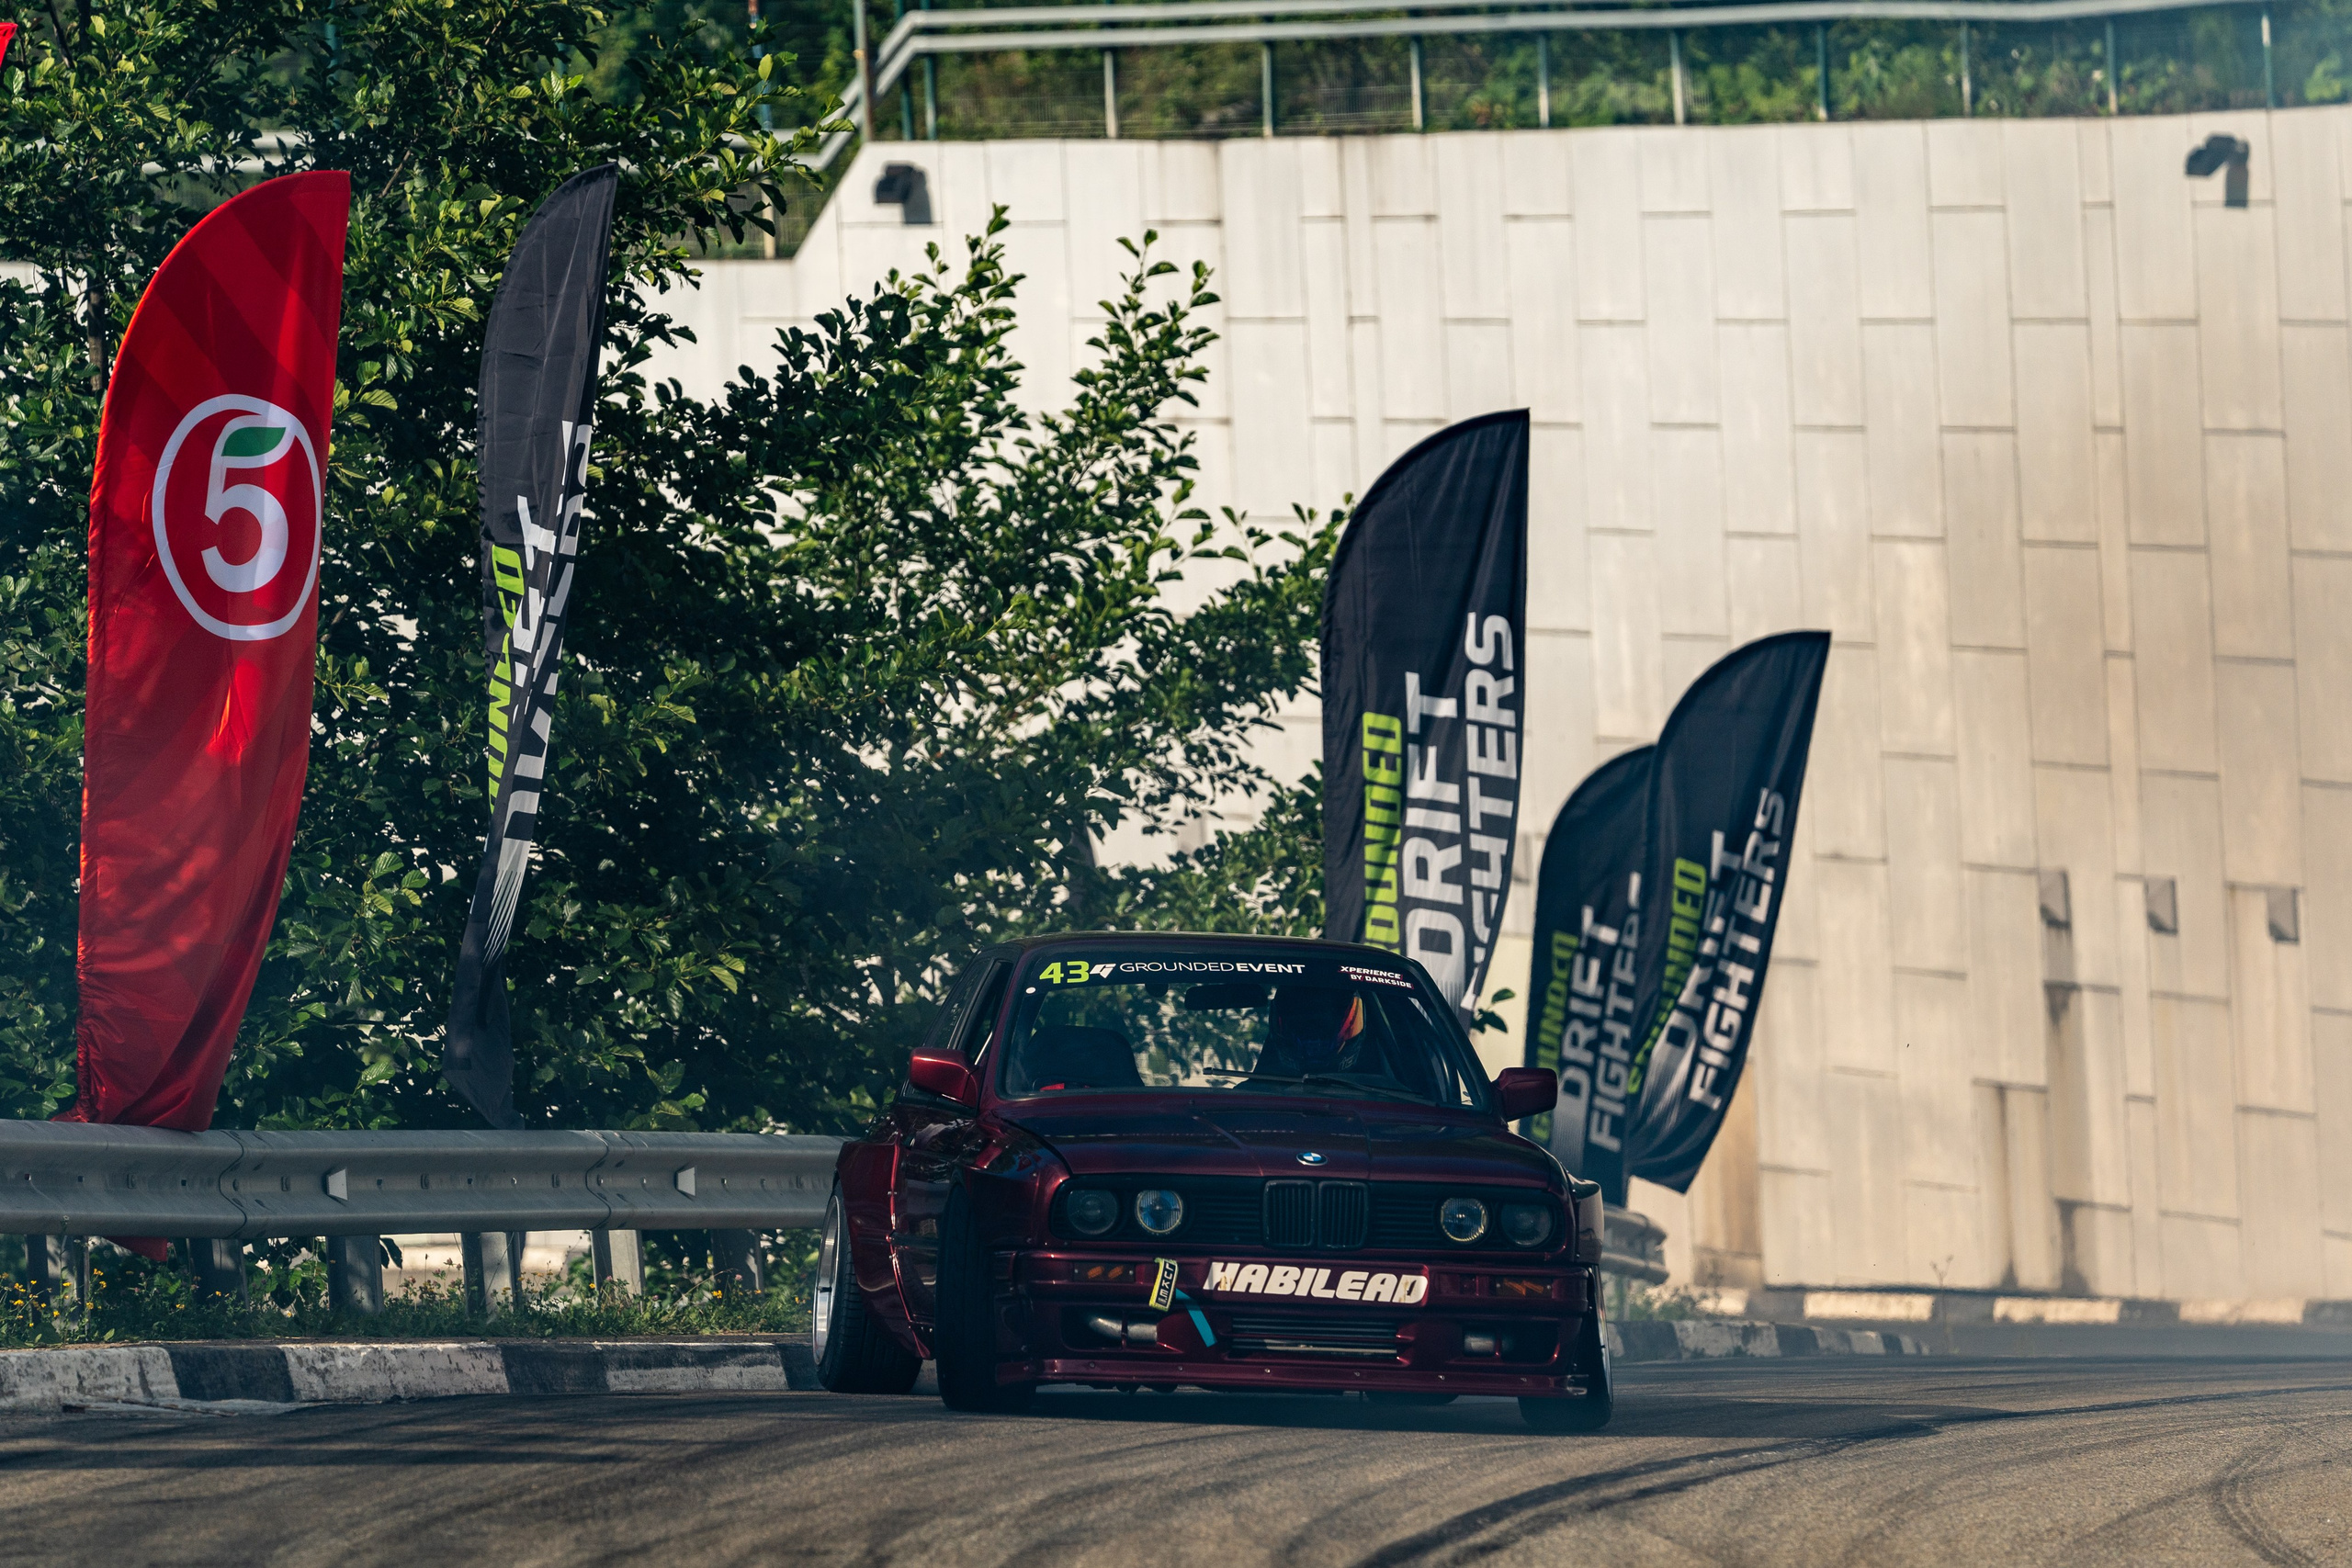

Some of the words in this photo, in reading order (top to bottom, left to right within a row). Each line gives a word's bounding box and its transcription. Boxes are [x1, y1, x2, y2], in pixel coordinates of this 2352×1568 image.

[201, 414, 295, 592] 5
[1403, 671, 1466, 990] DRIFT
[1039, 961, 1091, 985] 43
[1340, 965, 1401, 979] XPERIENCE
[1365, 976, 1413, 988] DARKSIDE
[1689, 787, 1787, 1111] FIGHTERS
[1556, 905, 1620, 1116] DRIFT
[1203, 1261, 1429, 1304] HABILEAD
